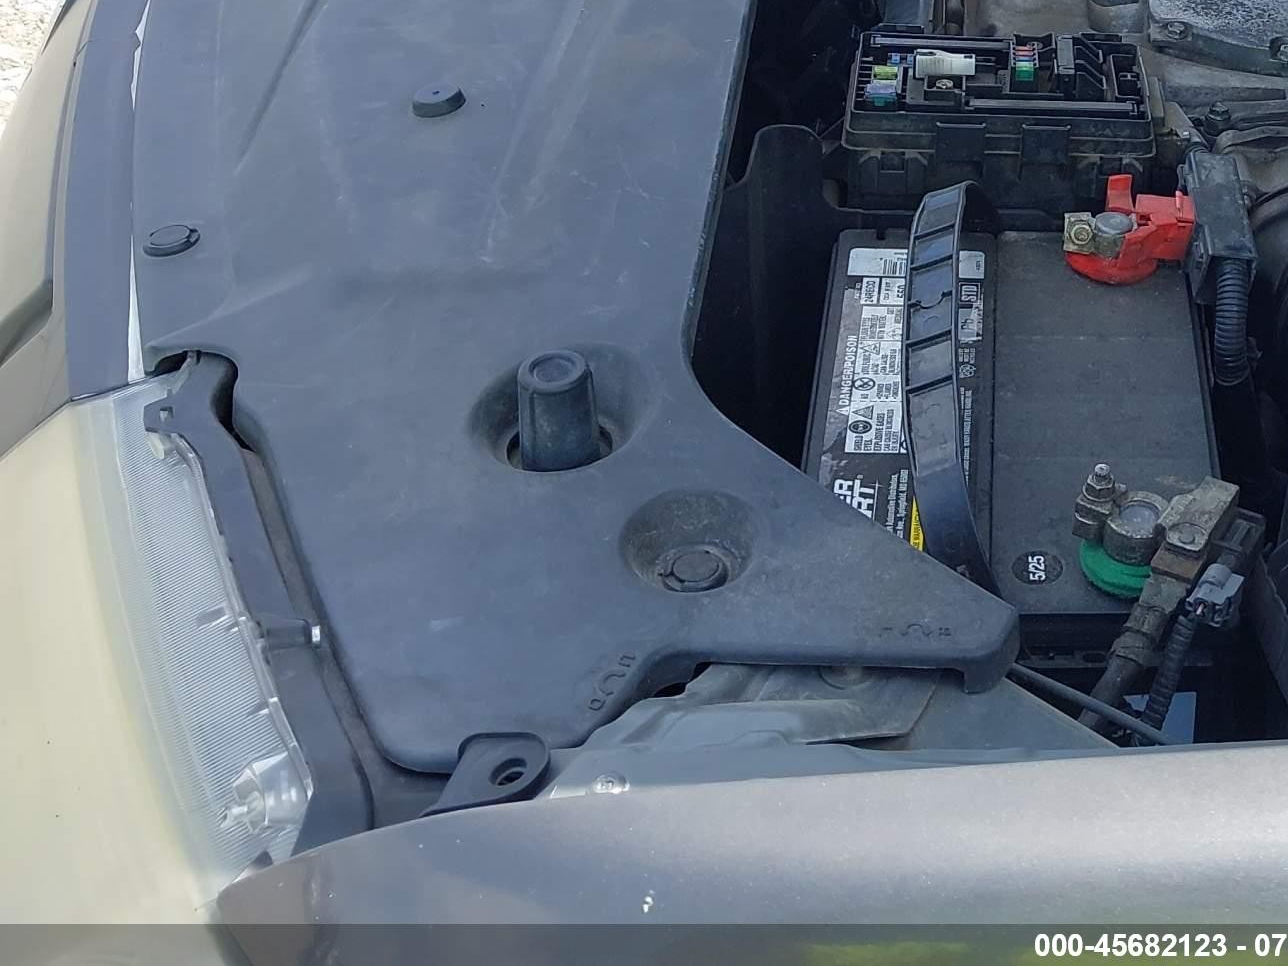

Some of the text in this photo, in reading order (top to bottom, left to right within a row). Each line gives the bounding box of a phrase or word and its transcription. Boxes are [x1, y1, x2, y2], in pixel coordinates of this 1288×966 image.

[961, 286, 977, 301] STD
[839, 336, 857, 406] DANGER/POISON
[1028, 556, 1045, 580] 5/25
